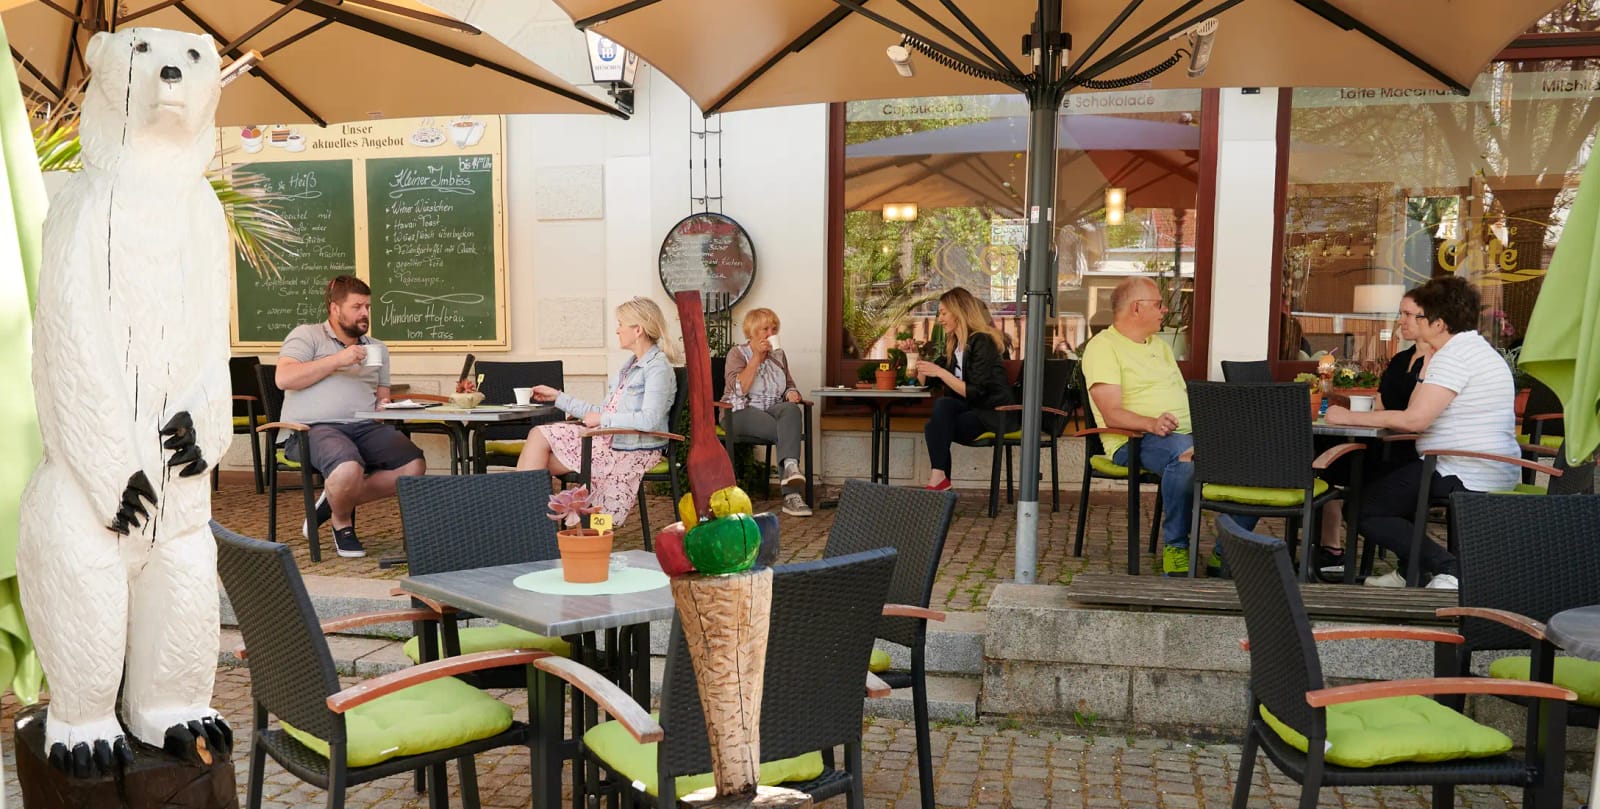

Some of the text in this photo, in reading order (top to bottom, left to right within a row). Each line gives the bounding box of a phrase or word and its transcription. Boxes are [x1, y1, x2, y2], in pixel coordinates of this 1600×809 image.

[1075, 94, 1155, 109] Schokolade
[342, 124, 373, 135] Unser
[312, 136, 404, 149] aktuelles Angebot
[389, 165, 471, 188] Kleiner Imbiss
[425, 303, 465, 327] Hofbräu
[425, 324, 454, 339] Fass
[593, 516, 605, 526] 20
